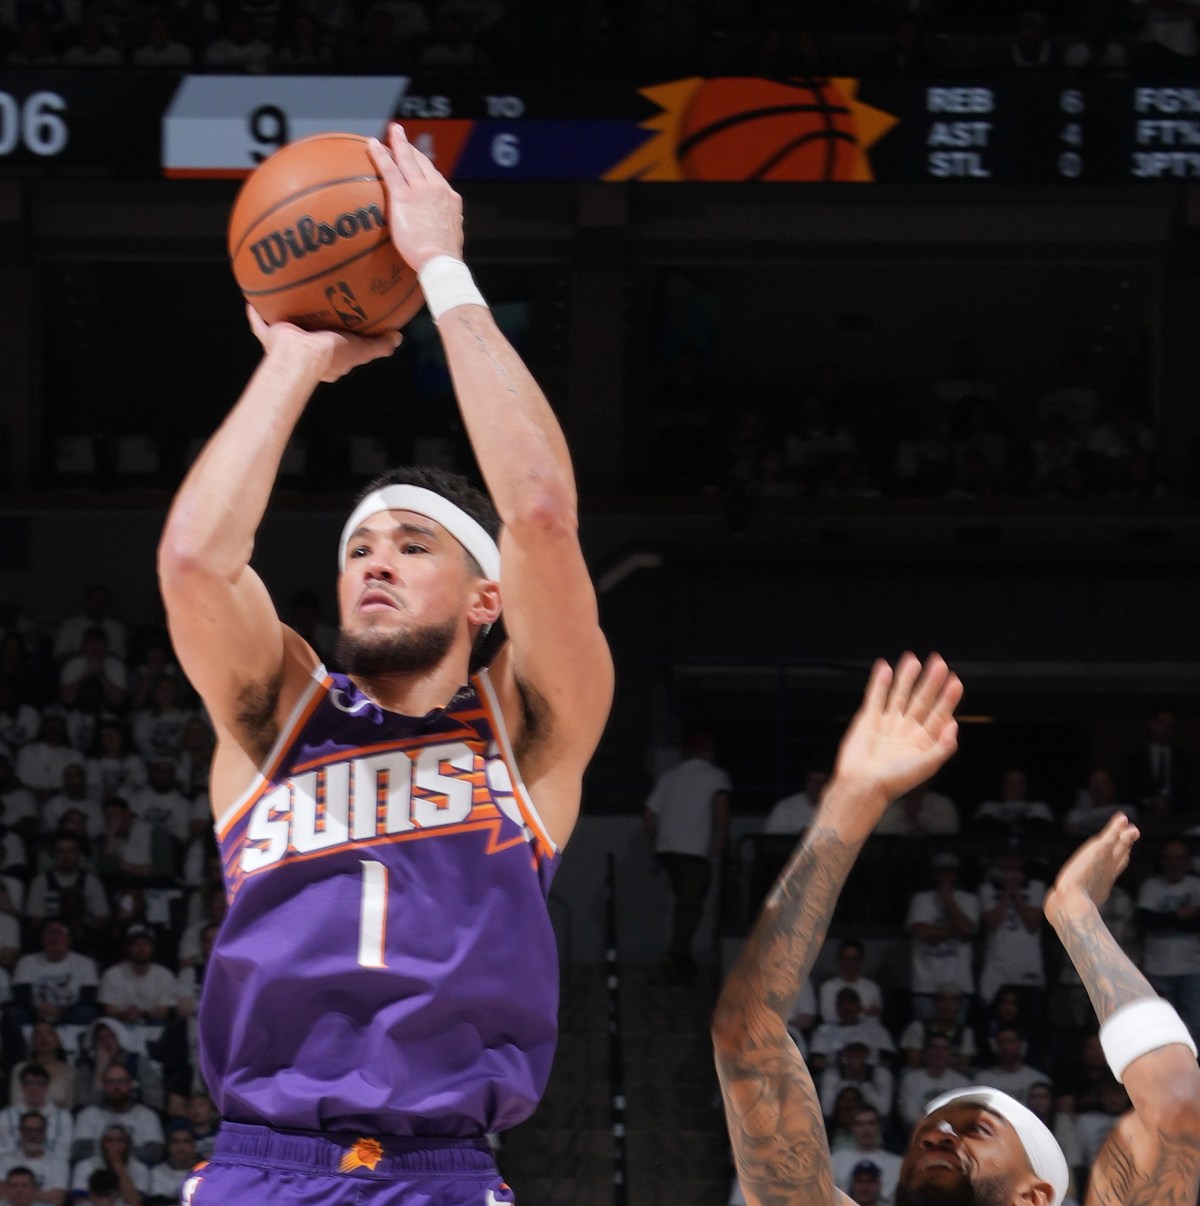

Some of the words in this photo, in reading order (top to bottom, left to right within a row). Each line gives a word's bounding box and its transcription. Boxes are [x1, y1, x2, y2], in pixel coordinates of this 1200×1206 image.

[483, 94, 526, 119] TO
[926, 86, 995, 114] REB
[249, 104, 289, 164] 9
[490, 132, 522, 168] 6
[926, 120, 995, 147] AST
[927, 150, 992, 178] STL
[250, 202, 386, 275] Wilson
[238, 740, 476, 874] SUNS
[356, 859, 390, 969] 1
